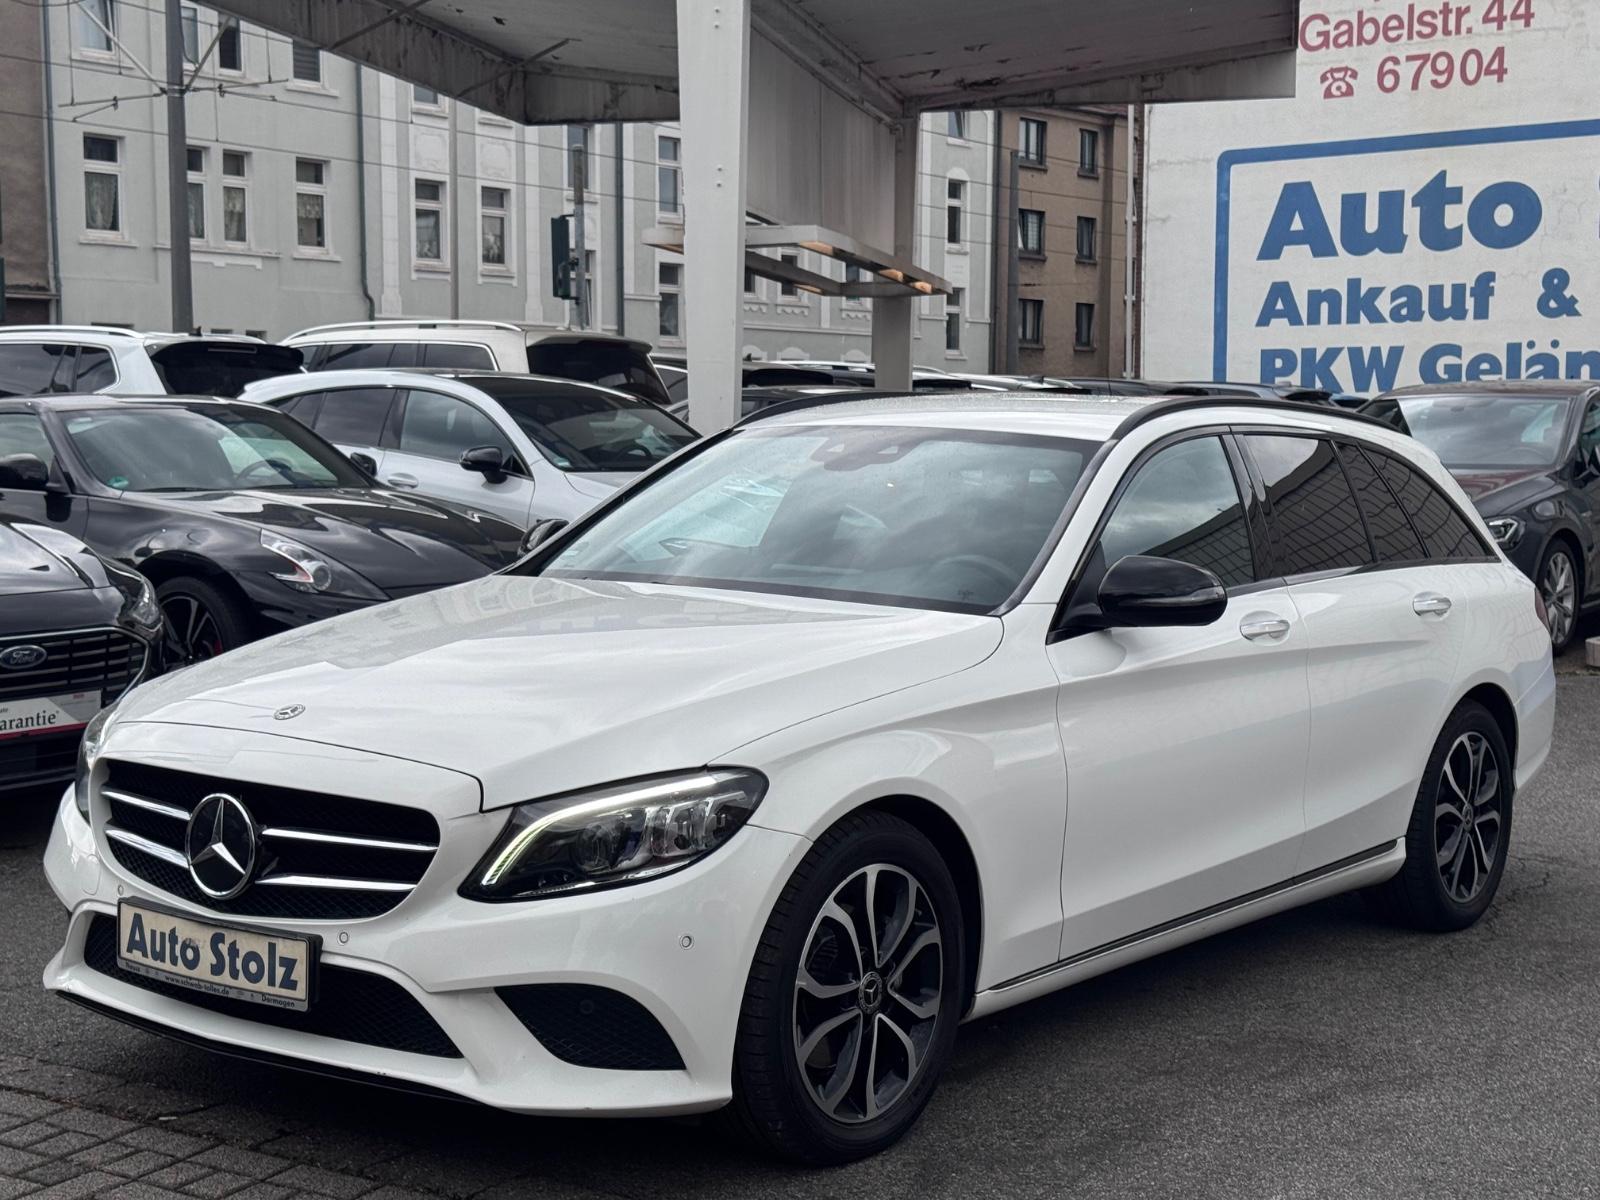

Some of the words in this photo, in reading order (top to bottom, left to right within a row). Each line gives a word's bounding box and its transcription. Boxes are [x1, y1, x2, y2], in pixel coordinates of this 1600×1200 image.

[1300, 2, 1473, 52] Gabelstr.
[1482, 0, 1535, 31] 44
[1377, 46, 1508, 94] 67904
[1256, 170, 1543, 261] Auto
[1255, 271, 1496, 327] Ankauf
[1537, 267, 1582, 319] &
[1260, 345, 1405, 394] PKW
[126, 912, 201, 971] Auto
[209, 931, 299, 991] Stolz
